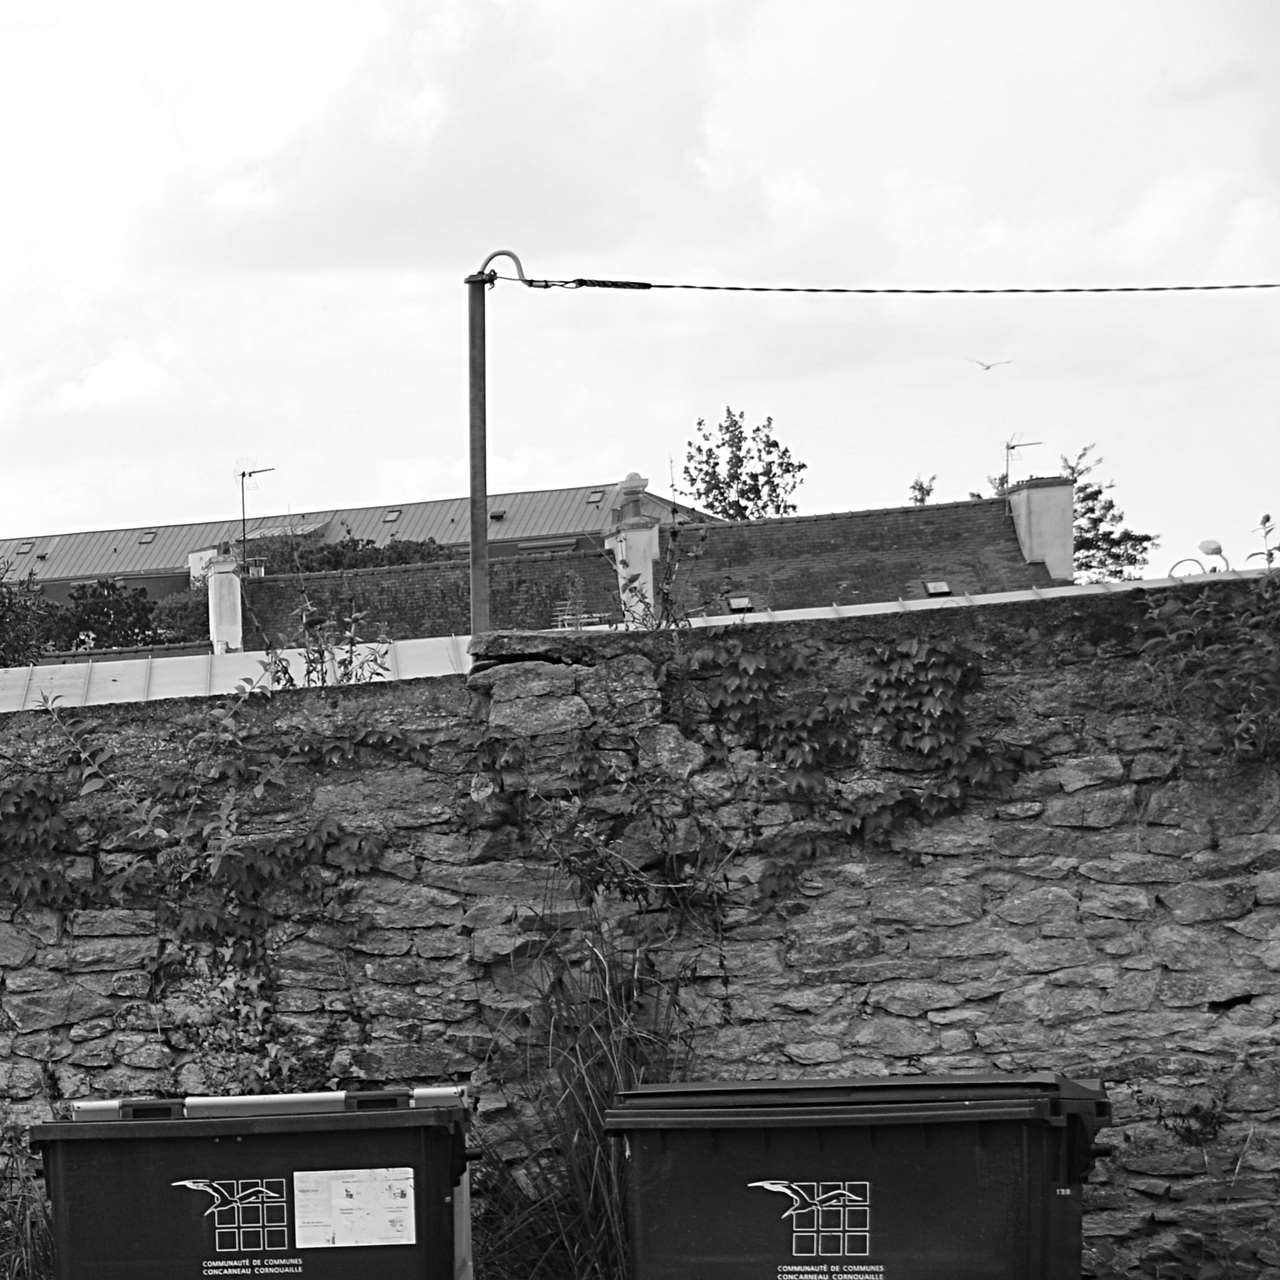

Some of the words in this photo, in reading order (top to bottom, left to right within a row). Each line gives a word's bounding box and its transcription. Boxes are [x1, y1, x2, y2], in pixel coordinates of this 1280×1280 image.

[202, 1258, 250, 1267] COMMUNAUTÉ
[202, 1268, 251, 1276] CONCARNEAU
[254, 1266, 303, 1274] CORNOUAILLE
[777, 1264, 827, 1272] COMMUNAUTÉ
[777, 1273, 829, 1280] CONCARNEAU
[831, 1273, 885, 1280] CORNOUAILLE
